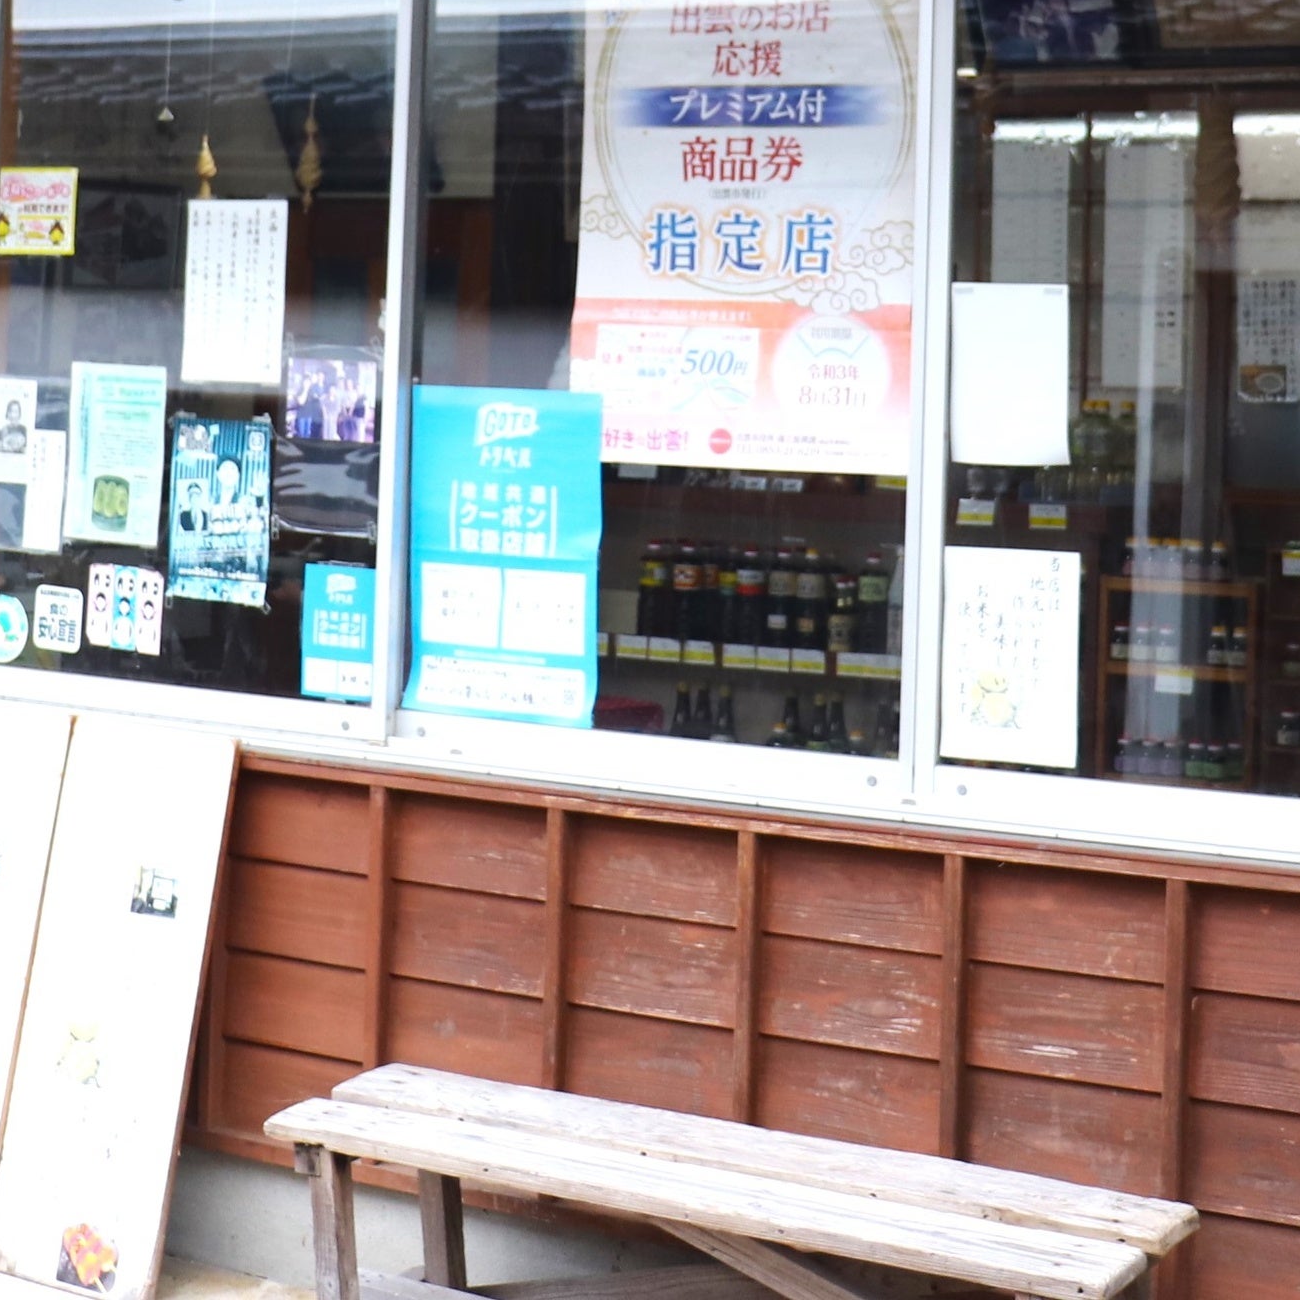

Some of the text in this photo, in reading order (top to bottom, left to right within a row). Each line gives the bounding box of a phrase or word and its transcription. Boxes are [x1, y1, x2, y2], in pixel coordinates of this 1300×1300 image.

[712, 40, 782, 77] 応援
[670, 88, 826, 124] プレミアム付
[679, 135, 802, 184] 商品券
[647, 212, 837, 275] 指定店
[681, 347, 748, 378] 500円
[807, 362, 859, 381] 令和3年
[460, 504, 547, 528] クーポン
